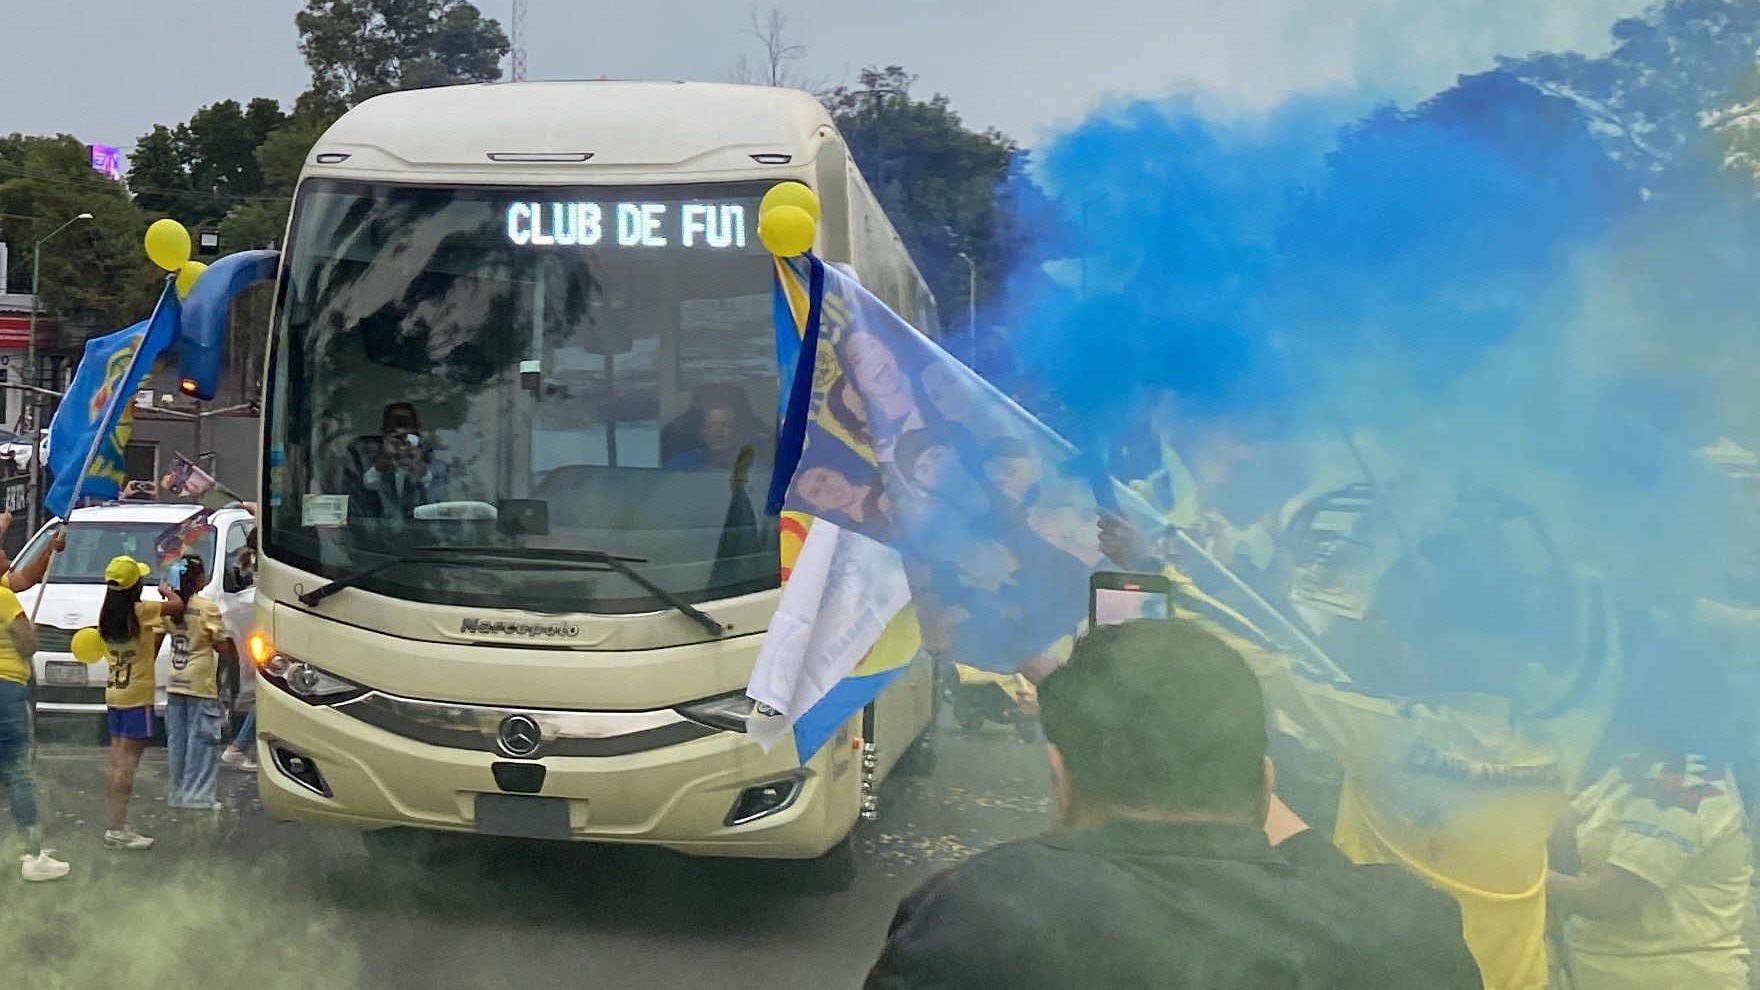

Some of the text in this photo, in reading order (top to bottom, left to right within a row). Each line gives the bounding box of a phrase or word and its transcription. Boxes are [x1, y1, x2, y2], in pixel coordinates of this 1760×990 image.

[508, 201, 602, 245] CLUB
[617, 203, 667, 246] DE
[460, 617, 580, 638] Marcopolo
